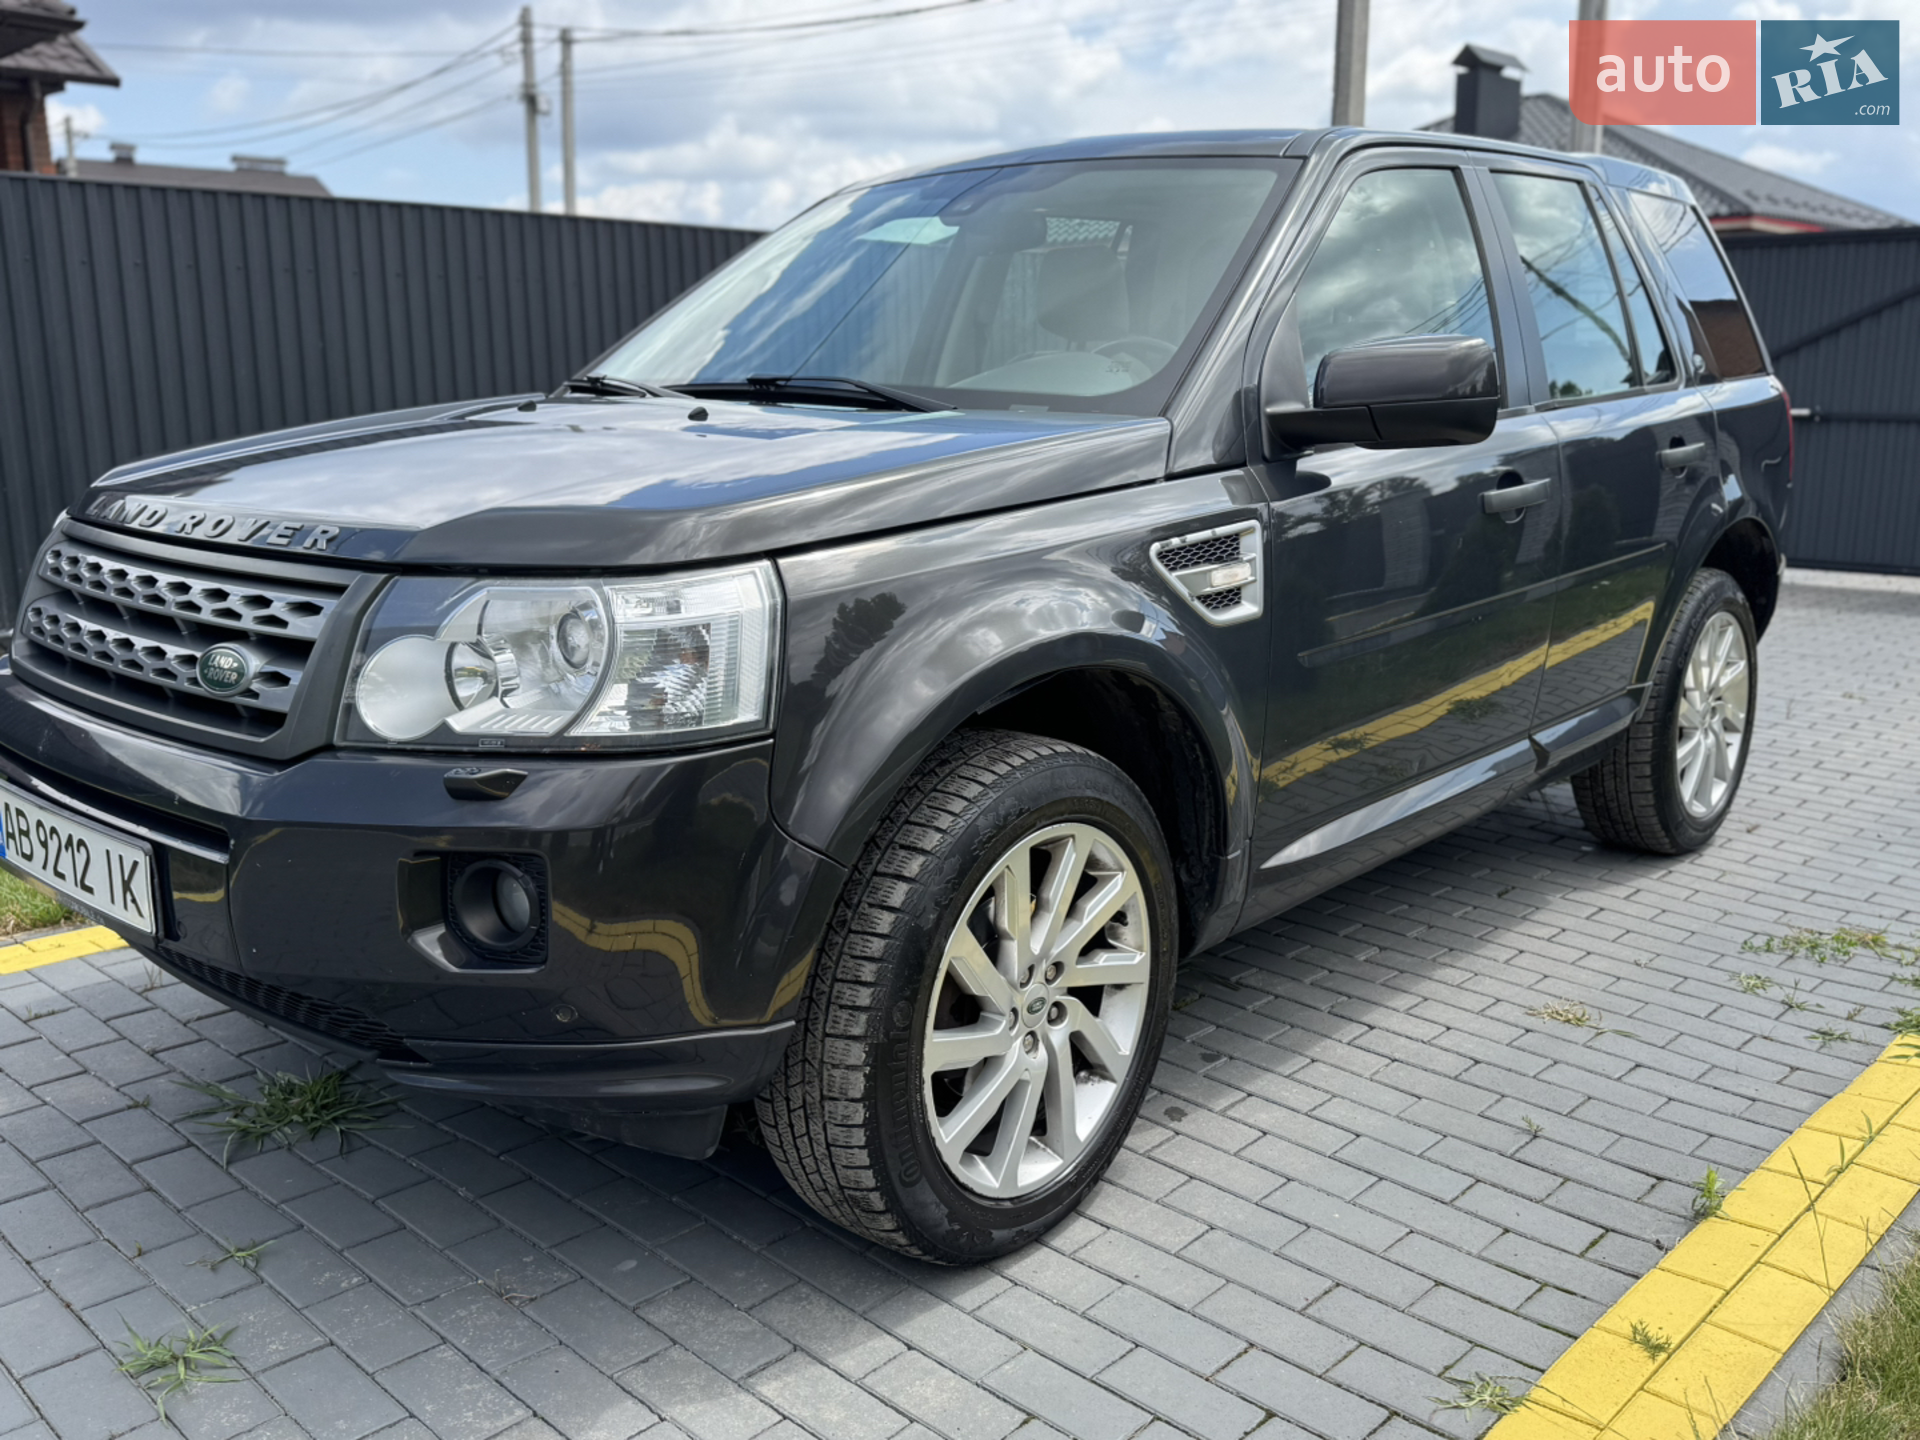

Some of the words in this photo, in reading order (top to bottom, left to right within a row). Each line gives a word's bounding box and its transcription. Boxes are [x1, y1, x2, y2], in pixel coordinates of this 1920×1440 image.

[85, 495, 168, 528] LAND
[175, 511, 342, 551] ROVER
[208, 654, 234, 669] LAND
[206, 667, 238, 685] ROVER
